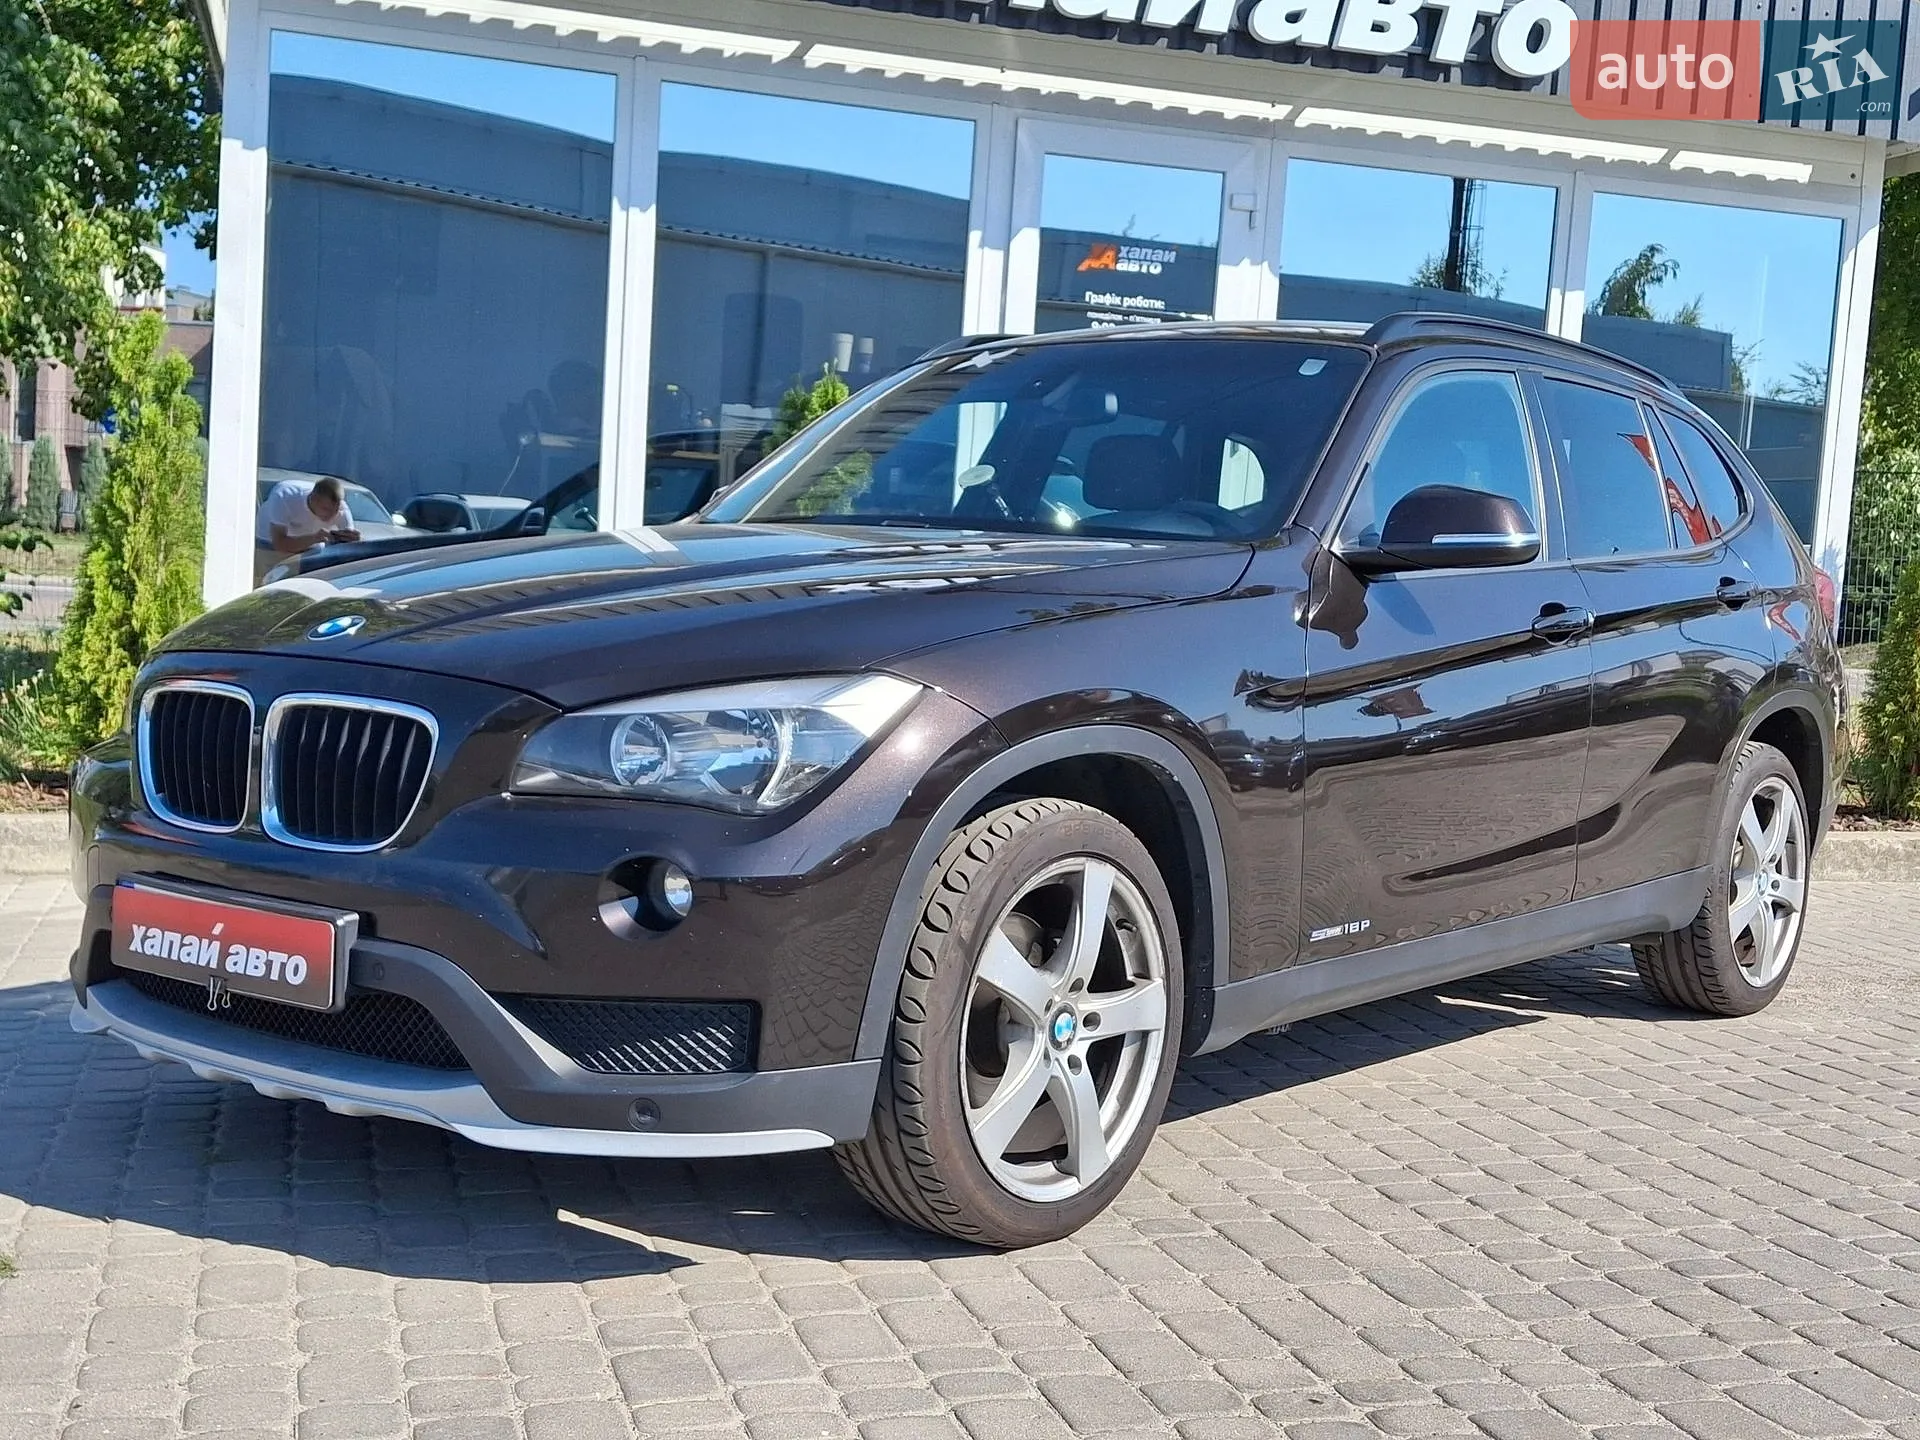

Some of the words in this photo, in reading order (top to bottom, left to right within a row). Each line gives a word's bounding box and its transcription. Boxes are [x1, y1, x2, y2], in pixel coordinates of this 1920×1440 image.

[1116, 258, 1162, 275] авто
[1085, 291, 1121, 306] Графік
[1122, 295, 1165, 309] роботи:
[128, 922, 224, 969] хапай
[224, 943, 308, 986] авто
